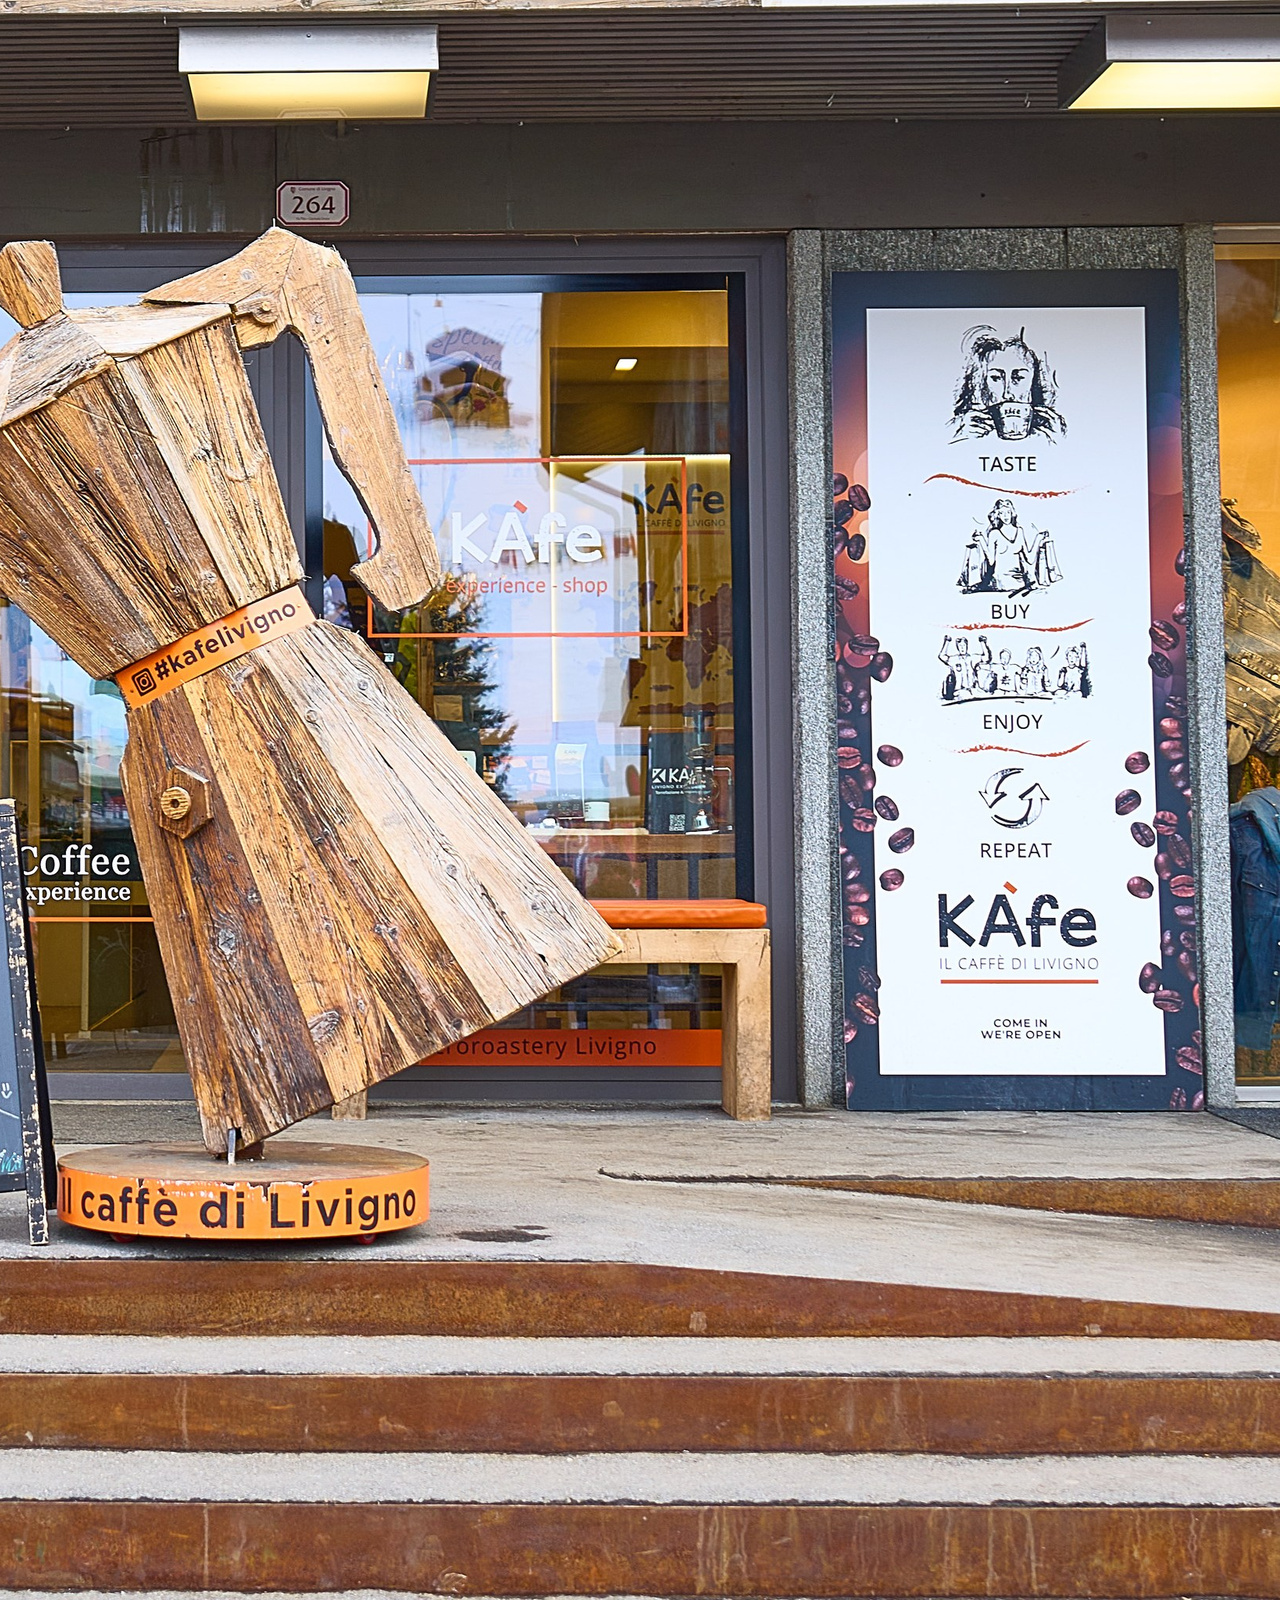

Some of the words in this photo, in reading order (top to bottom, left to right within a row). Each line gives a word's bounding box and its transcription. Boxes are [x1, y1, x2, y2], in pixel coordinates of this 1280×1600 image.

[291, 196, 336, 214] 264
[979, 456, 1037, 472] TASTE
[446, 577, 546, 596] experience
[563, 577, 608, 596] shop
[991, 604, 1030, 619] BUY
[153, 603, 296, 681] #kafelivigno
[983, 714, 1043, 733] ENJOY
[21, 844, 130, 876] Coffee
[980, 843, 1052, 858] REPEAT
[25, 881, 131, 905] xperience
[938, 881, 1098, 948] KÀfe
[939, 957, 952, 970] IL
[958, 954, 1005, 970] CAFFÈ
[1011, 957, 1027, 970] DI
[1034, 957, 1099, 970] LIVIGNO
[993, 1018, 1030, 1028] COME
[1035, 1018, 1048, 1028] IN
[981, 1030, 1021, 1039] WE'RE
[1025, 1030, 1061, 1039] OPEN
[576, 1036, 657, 1060] Livigno
[61, 1176, 72, 1214] Il
[81, 1186, 177, 1227] caffè
[199, 1191, 244, 1229] di
[270, 1185, 416, 1231] Livigno
